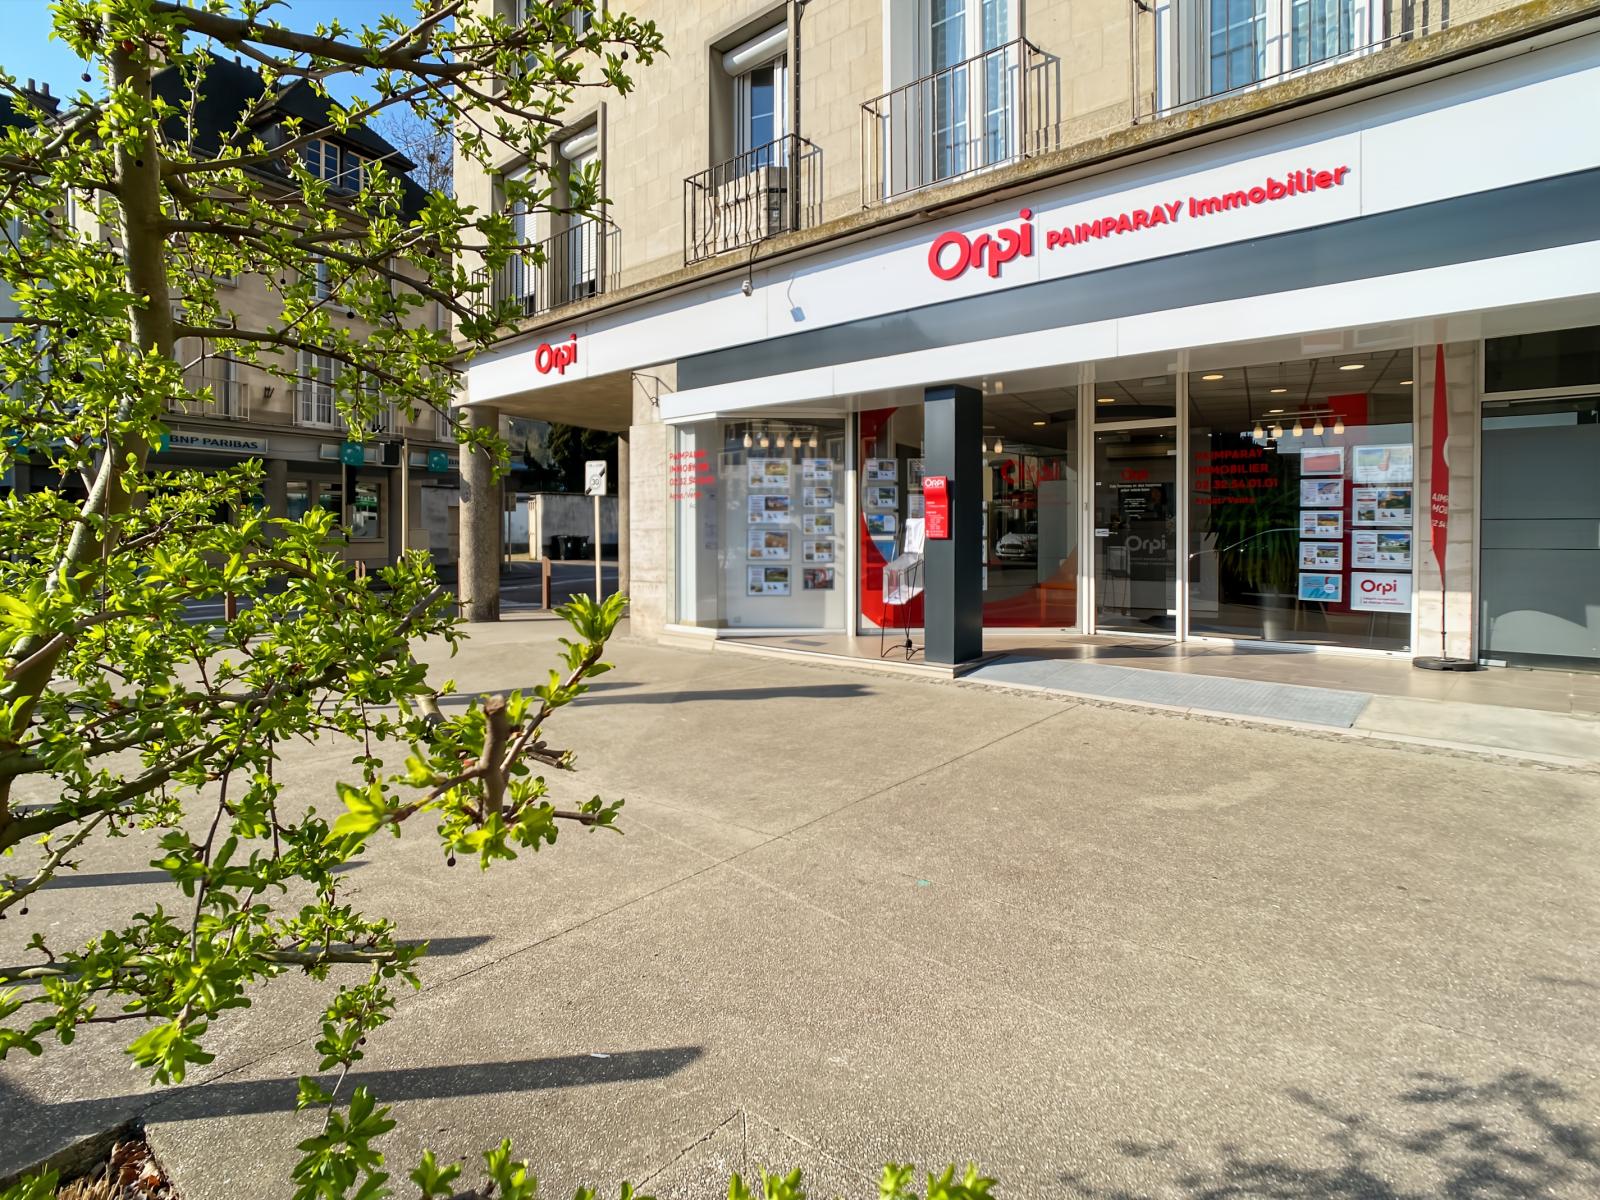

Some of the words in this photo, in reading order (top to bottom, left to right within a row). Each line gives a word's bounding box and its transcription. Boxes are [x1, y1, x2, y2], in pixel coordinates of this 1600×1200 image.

[928, 208, 1032, 281] Orpi
[1046, 201, 1181, 249] PAIMPARAY
[1189, 166, 1349, 217] Immobilier
[535, 333, 577, 375] Orpi
[169, 434, 199, 444] BNP
[203, 437, 258, 449] PARIBAS
[1125, 534, 1166, 555] Orpi
[1360, 579, 1397, 596] Orpi
